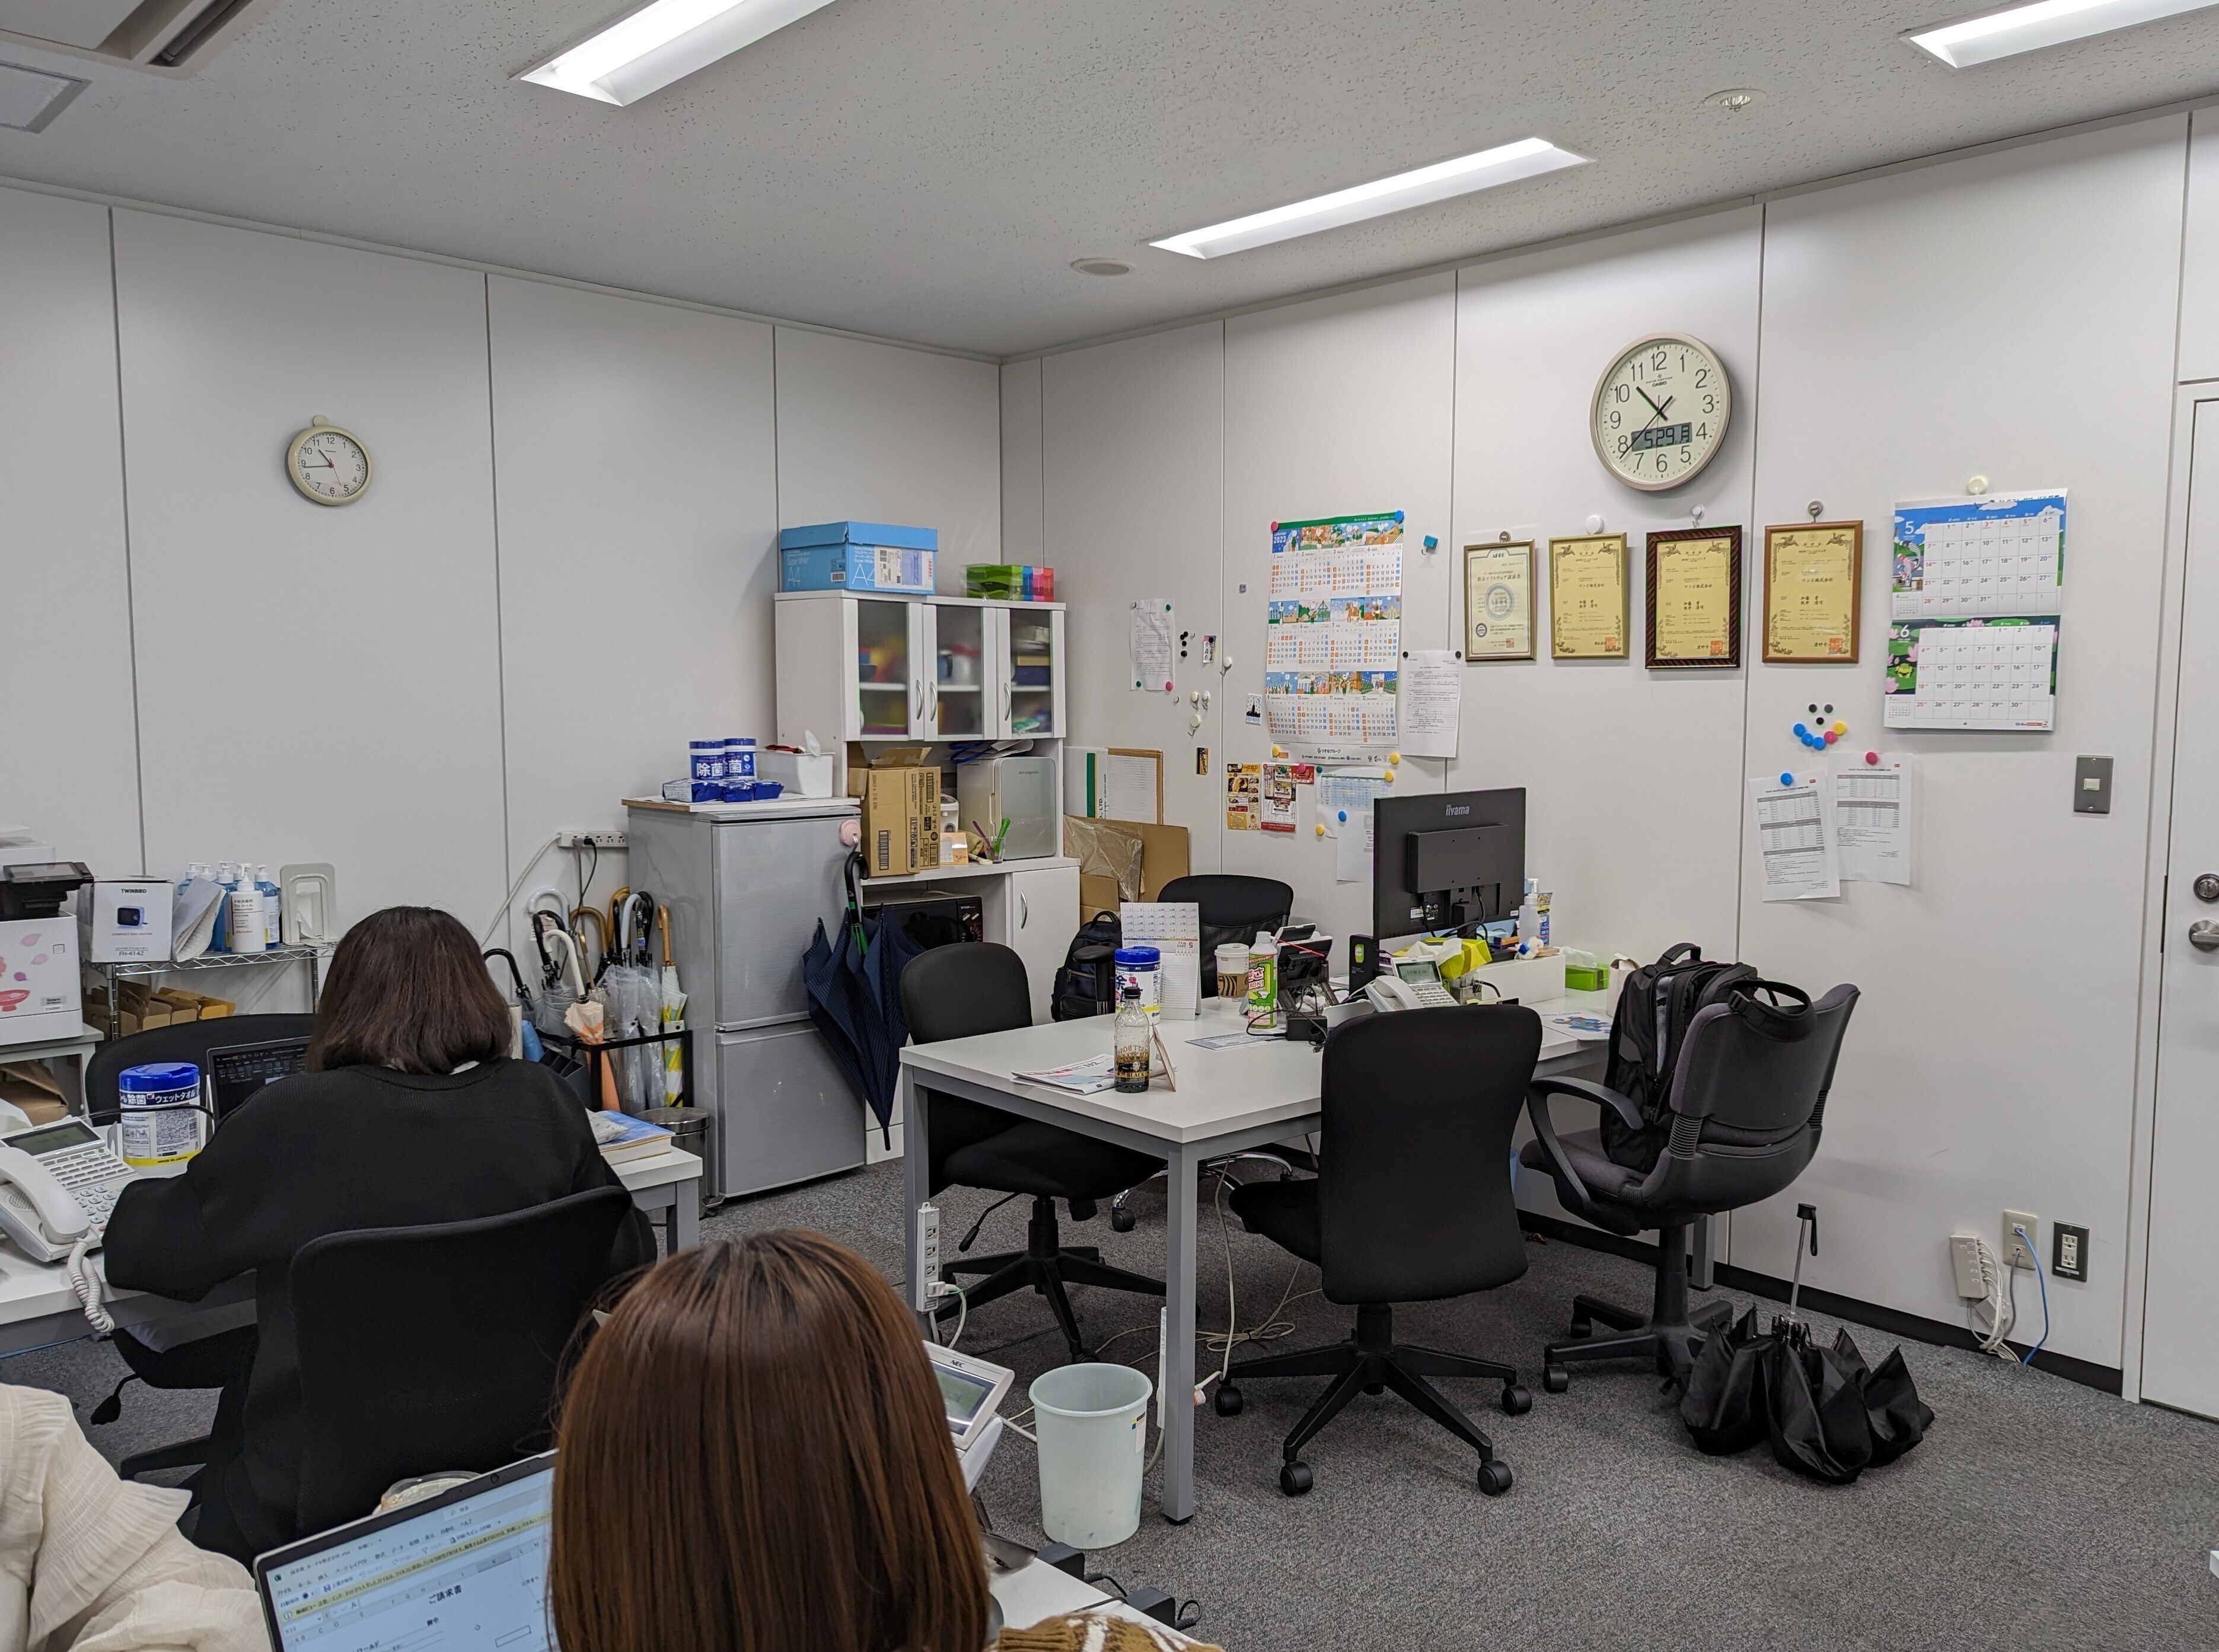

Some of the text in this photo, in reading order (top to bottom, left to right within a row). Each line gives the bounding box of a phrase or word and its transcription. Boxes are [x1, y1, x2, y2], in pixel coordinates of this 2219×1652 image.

[1651, 352, 1667, 371] 12
[1680, 354, 1684, 372] 1
[1631, 362, 1643, 381] 11
[1695, 369, 1707, 389] 2
[1614, 384, 1630, 403] 10
[1702, 395, 1714, 413] 3
[1610, 411, 1621, 429] 9
[1695, 422, 1707, 439] 4
[1618, 435, 1628, 453] 8
[1634, 452, 1644, 470] 7
[1656, 454, 1668, 472] 6
[1680, 445, 1691, 463] 5
[1905, 521, 1914, 534] 5
[787, 566, 801, 586] A4
[1900, 624, 1909, 637] 6
[697, 763, 723, 777] 除菌
[1446, 804, 1469, 815] iiyama
[127, 1089, 195, 1105] 除菌 ウェットタオル
[429, 1584, 462, 1605] ご請求書
